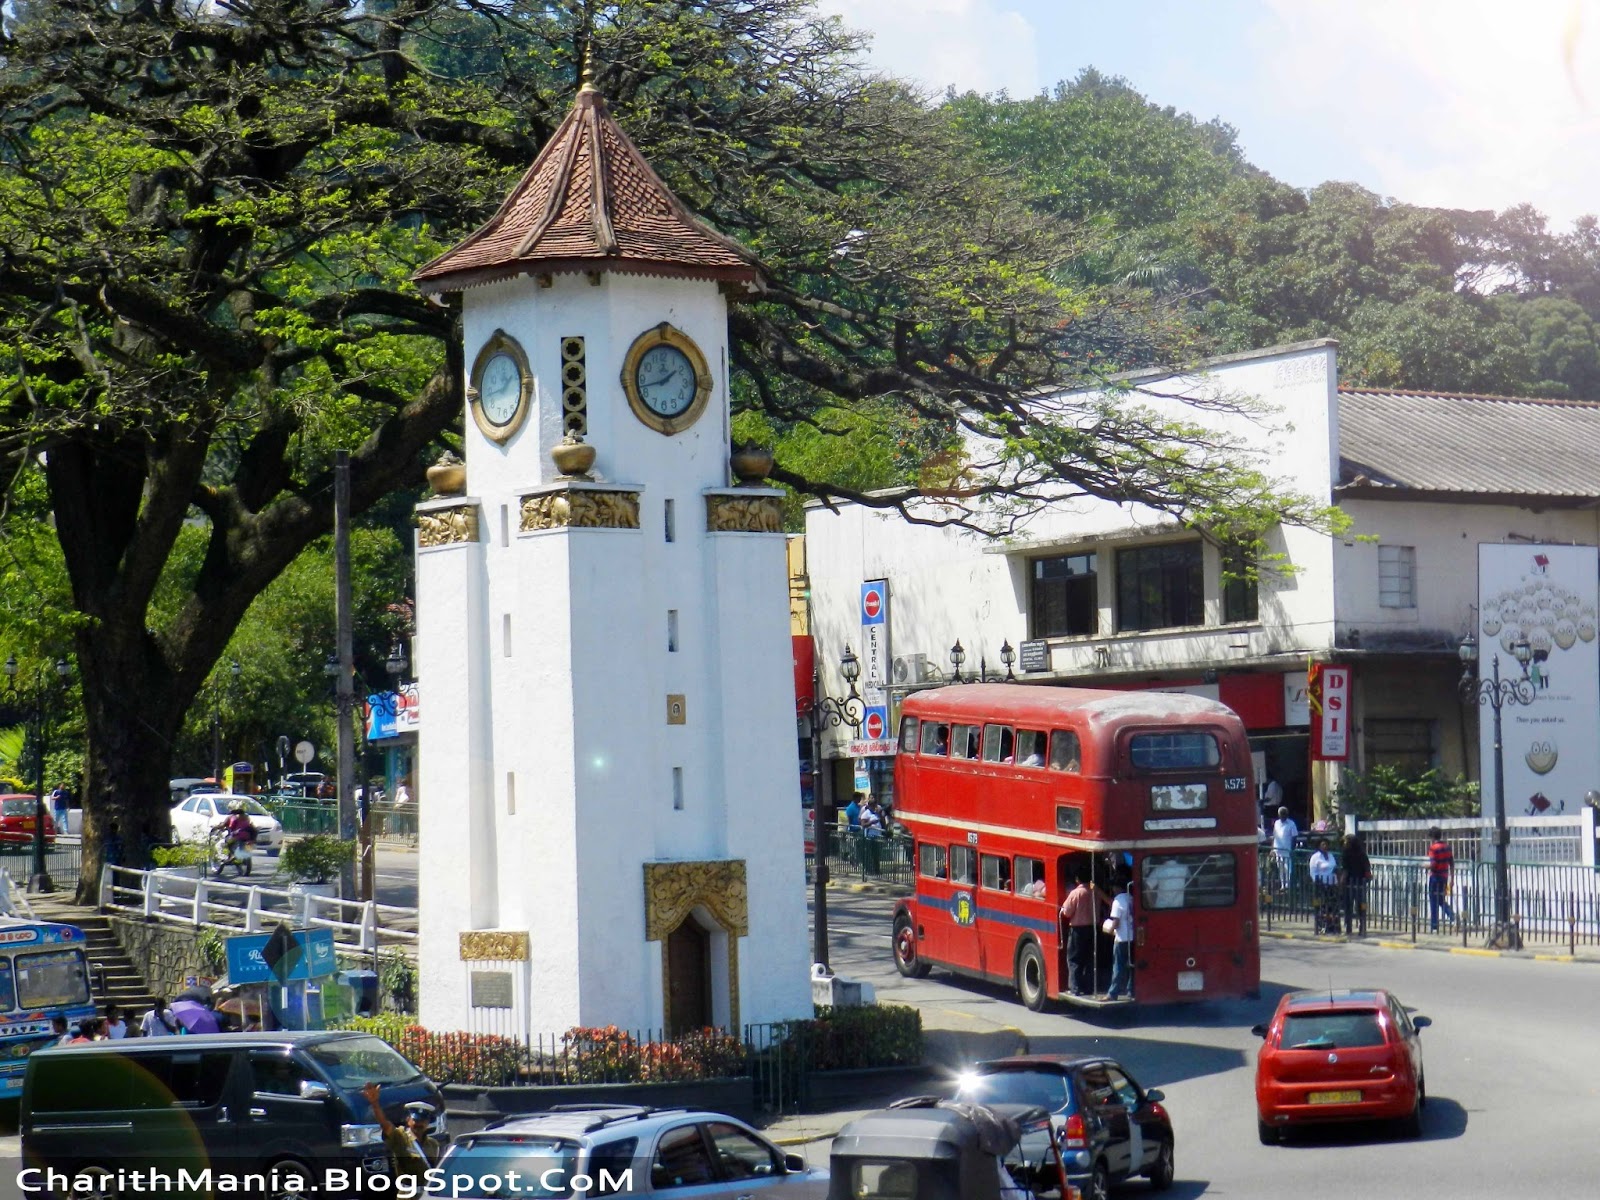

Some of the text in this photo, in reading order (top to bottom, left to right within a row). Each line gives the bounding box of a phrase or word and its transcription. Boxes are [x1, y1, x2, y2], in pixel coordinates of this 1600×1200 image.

[679, 365, 685, 376] 2
[640, 374, 646, 385] 9
[682, 378, 688, 389] 3
[643, 387, 649, 398] 8
[678, 389, 684, 400] 4
[652, 398, 658, 408] 7
[661, 400, 667, 411] 6
[670, 399, 677, 409] 5
[1328, 674, 1344, 732] DSI
[2, 1025, 37, 1034] TATA
